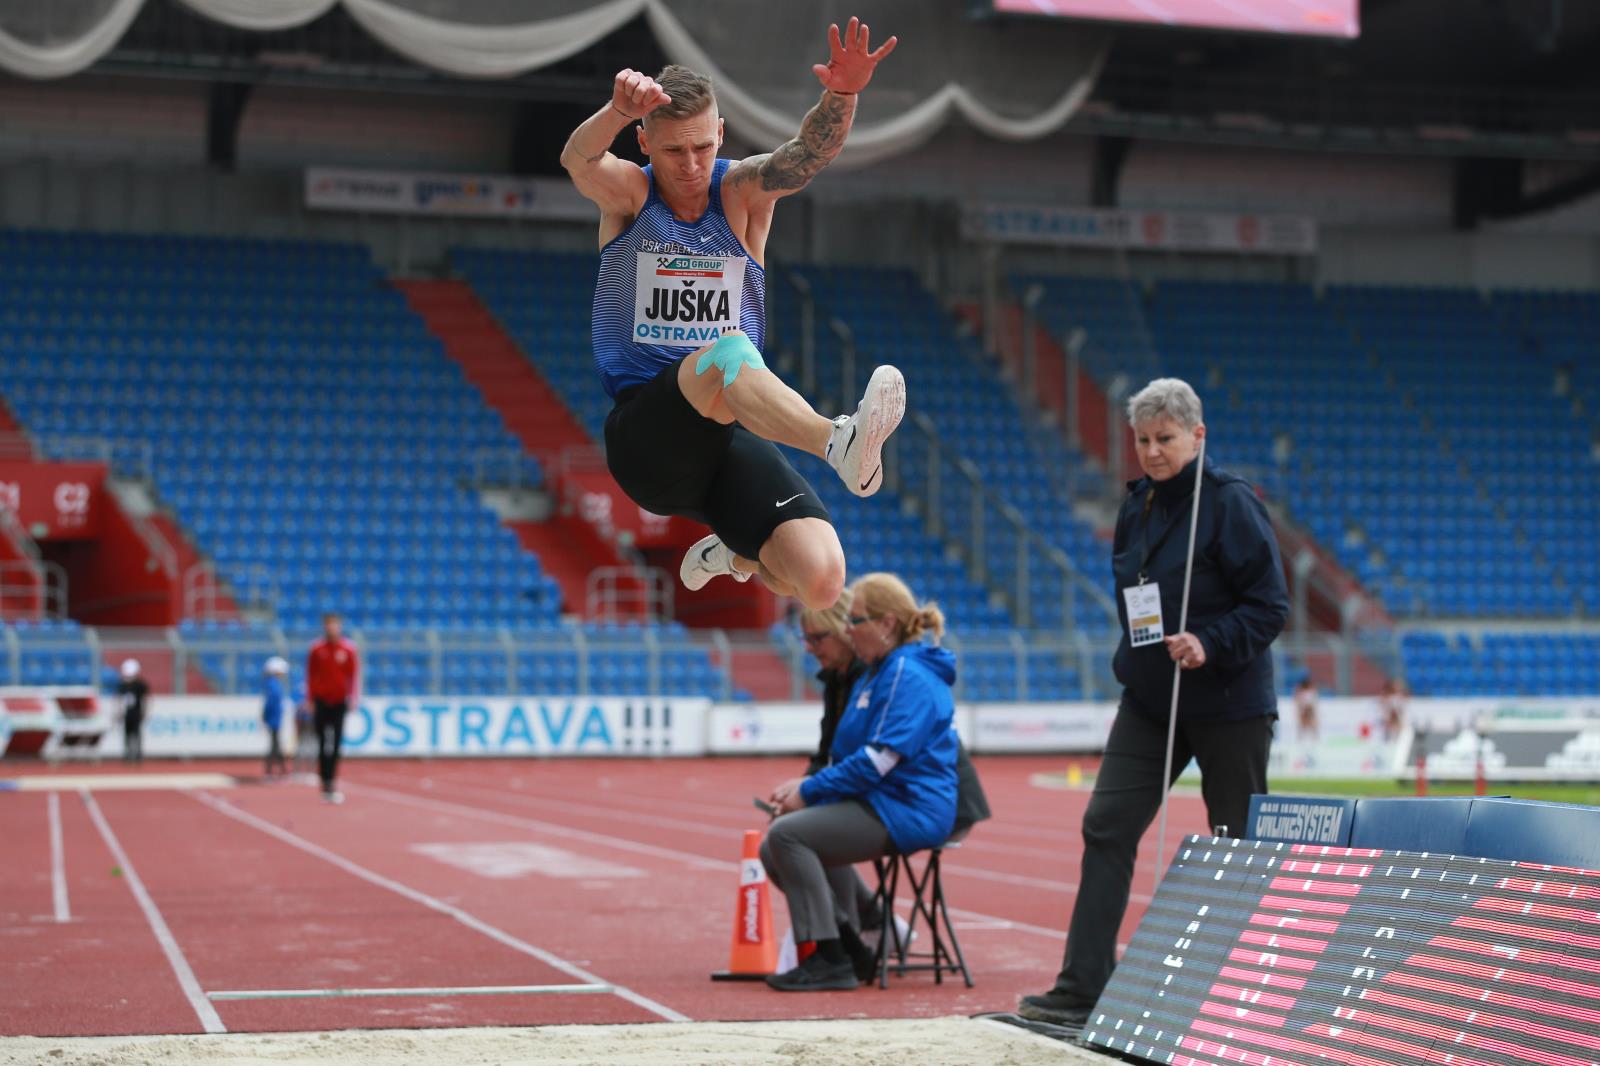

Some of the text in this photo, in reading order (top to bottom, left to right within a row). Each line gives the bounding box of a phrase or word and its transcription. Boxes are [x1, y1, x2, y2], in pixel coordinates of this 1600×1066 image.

[675, 258, 722, 270] SD GROUP
[645, 280, 730, 323] JUŠKA
[636, 323, 737, 341] OSTRAVA
[53, 481, 91, 513] C2
[340, 704, 673, 749] OSTRAVA!!!
